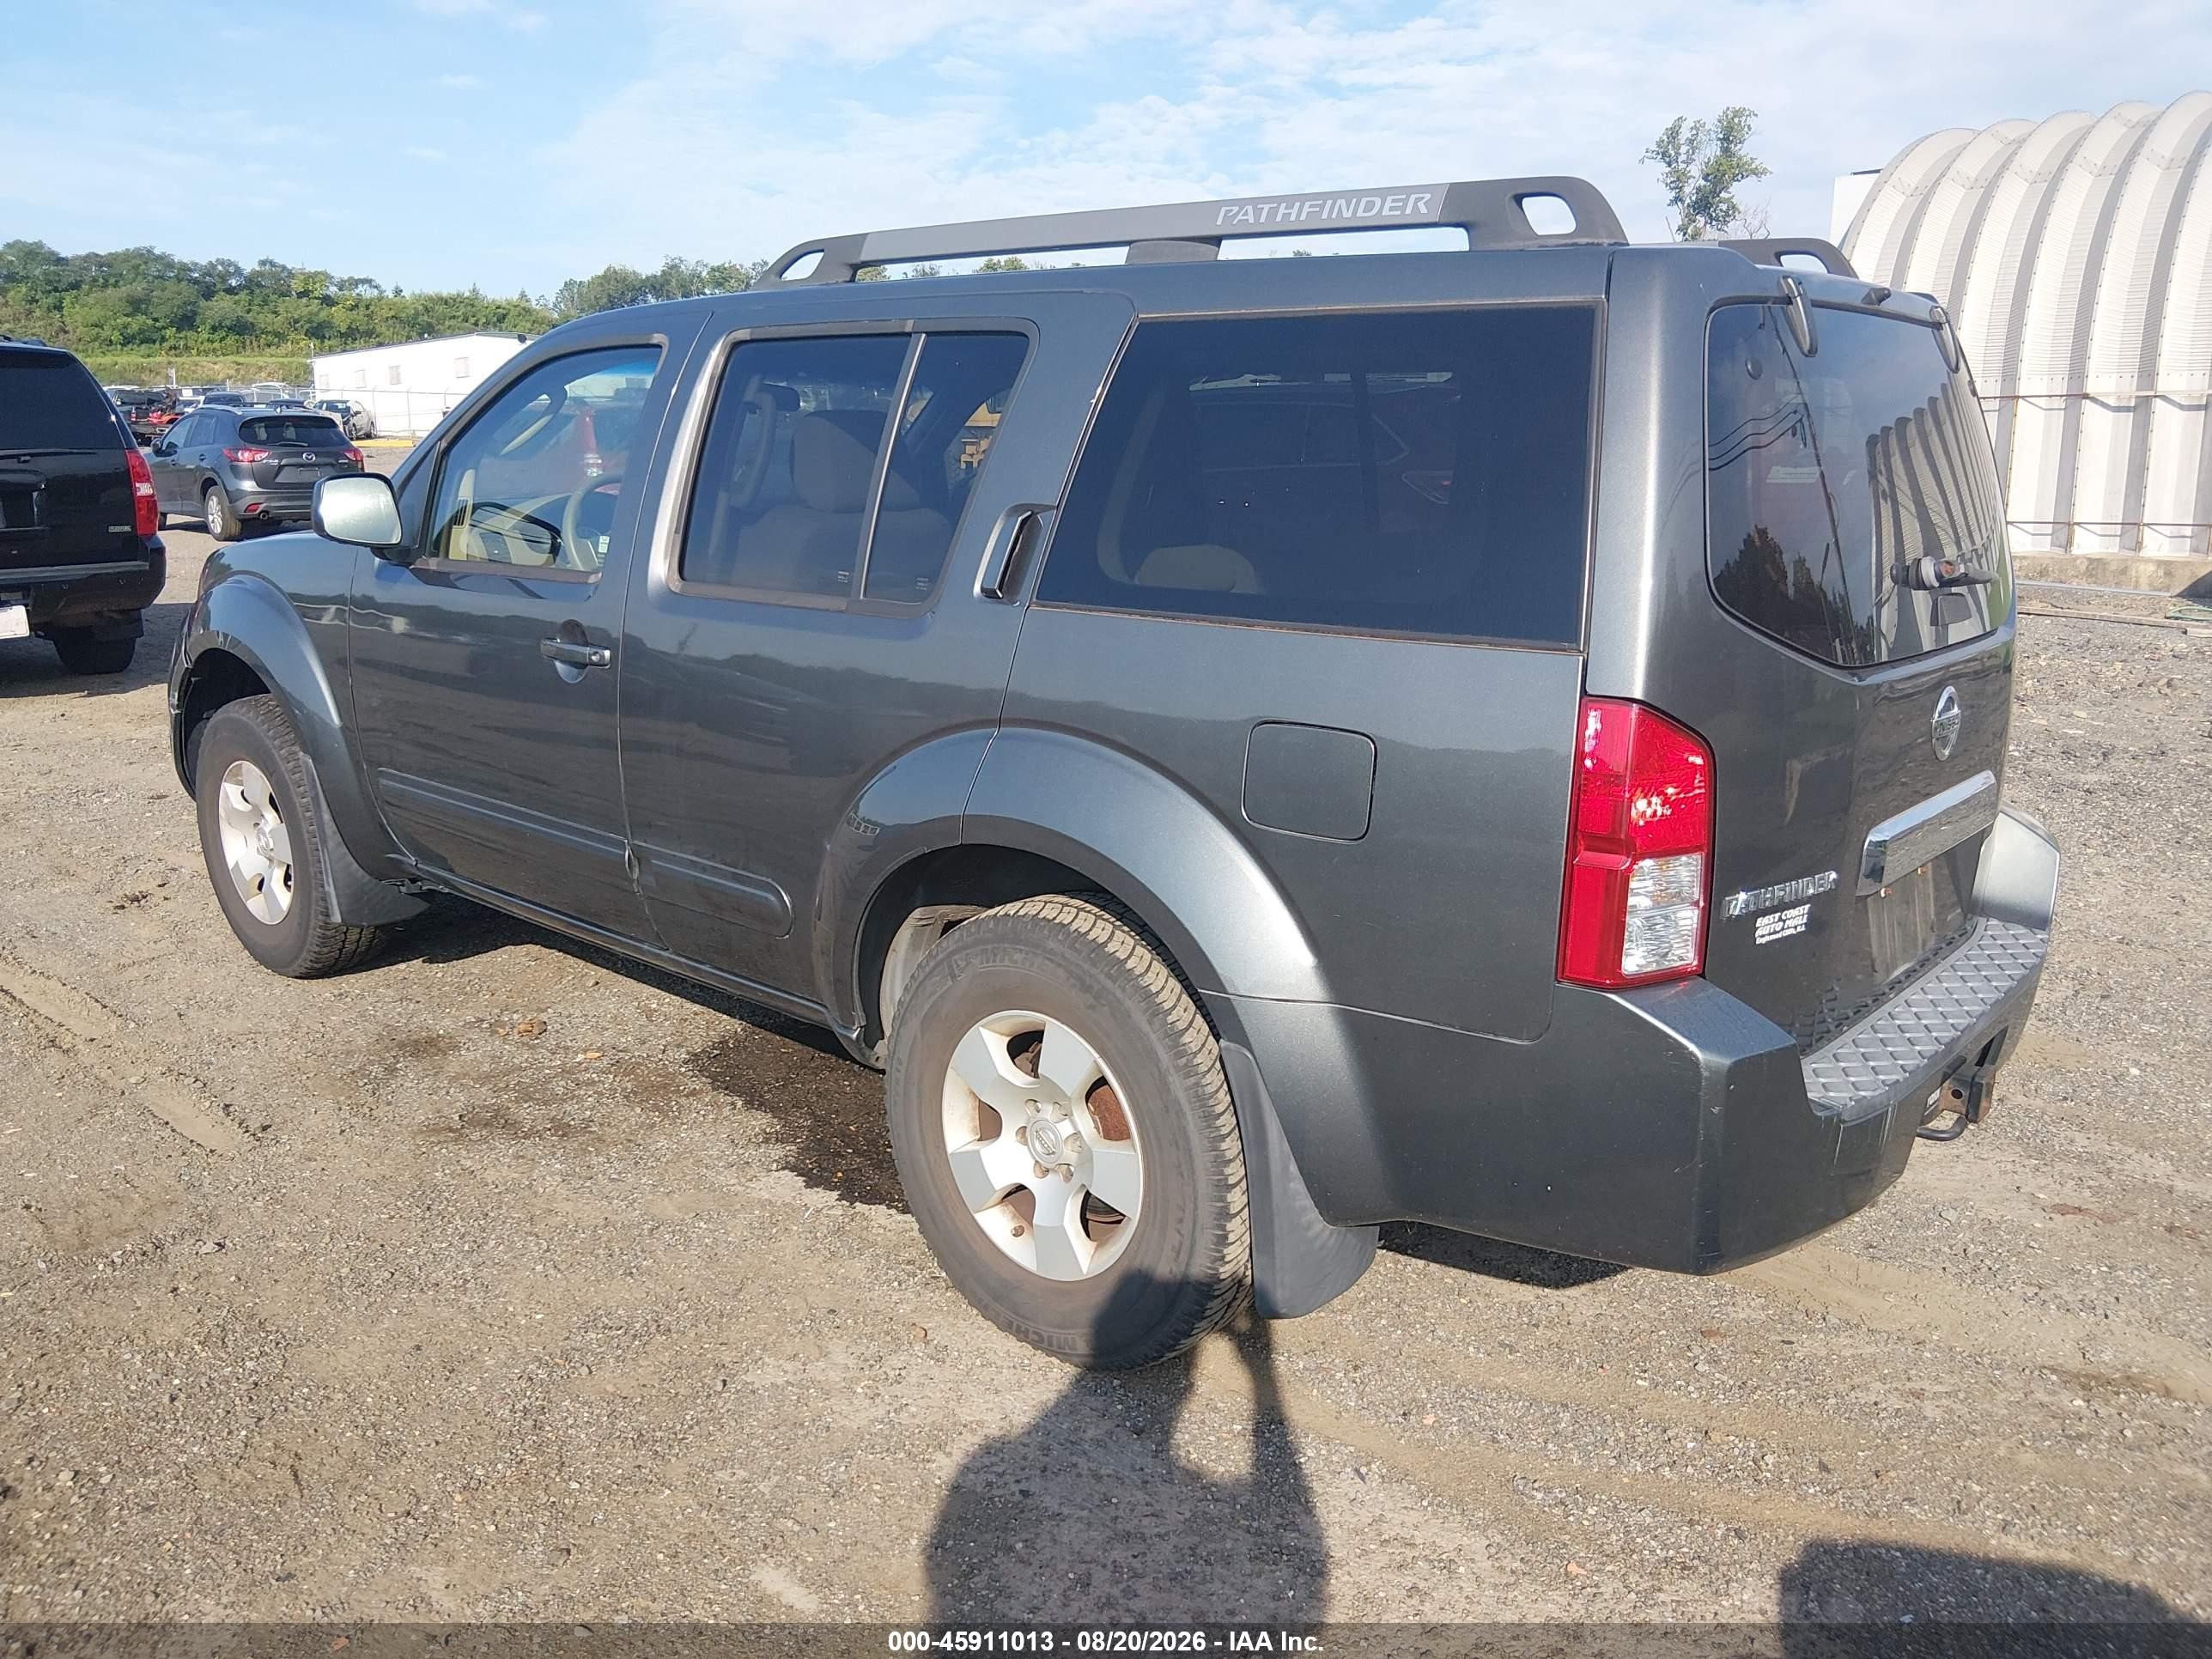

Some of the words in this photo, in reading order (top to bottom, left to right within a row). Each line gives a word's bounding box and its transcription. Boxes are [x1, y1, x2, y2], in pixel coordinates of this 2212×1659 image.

[1215, 192, 1432, 226] PATHFINDER
[1754, 921, 1784, 938] AUTO
[1784, 914, 1808, 929] MALL
[1755, 912, 1781, 927] EAST
[1781, 903, 1811, 920] COAST
